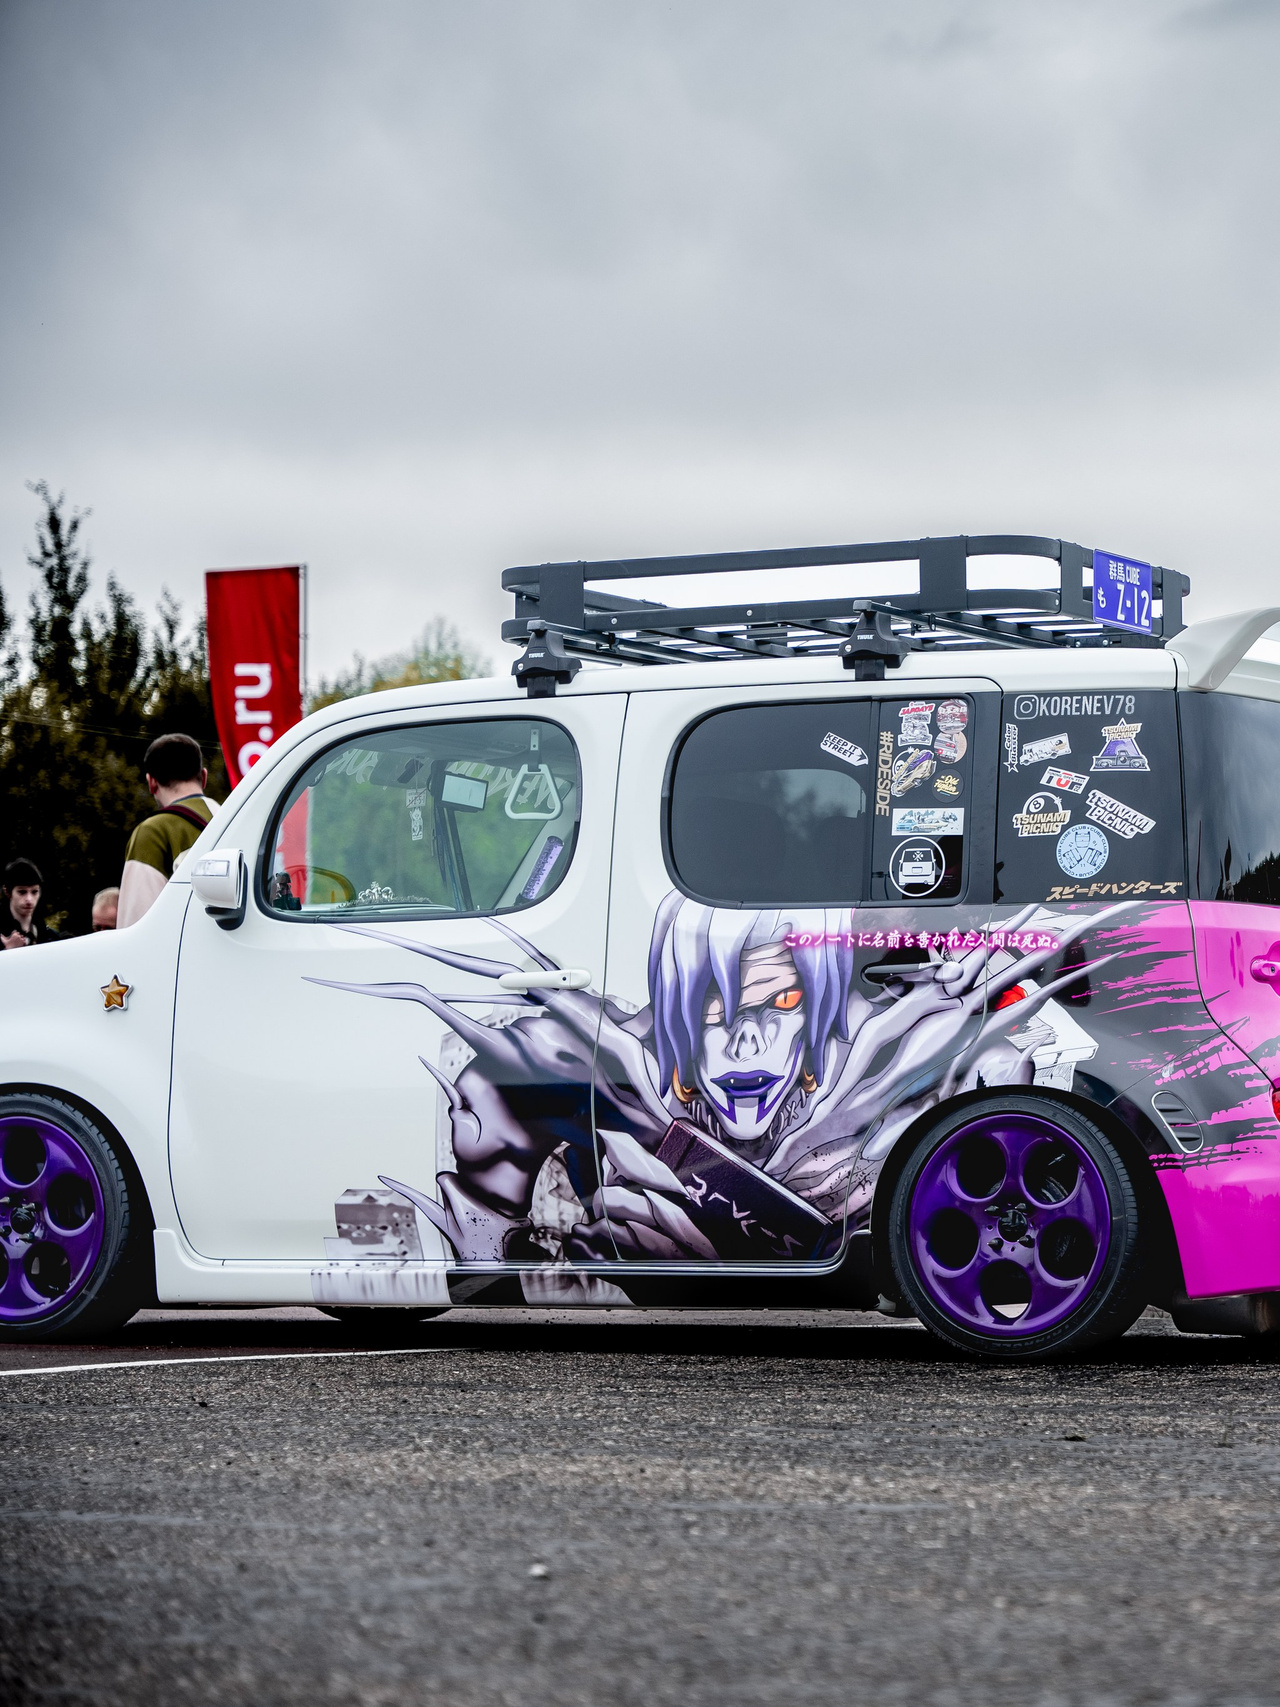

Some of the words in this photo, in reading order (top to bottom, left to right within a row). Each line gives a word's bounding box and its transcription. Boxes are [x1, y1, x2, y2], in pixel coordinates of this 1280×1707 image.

[1040, 694, 1135, 716] KORENEV78
[822, 740, 855, 758] STREET
[826, 733, 848, 747] KEEP
[849, 744, 859, 753] IT
[875, 731, 895, 817] #RIDESIDE
[1015, 811, 1069, 823] TSUNAMI
[1090, 791, 1153, 832] TSUNAMI
[1091, 806, 1138, 837] PICNIC
[1022, 822, 1062, 834] PICNIC
[1046, 880, 1182, 901] スピードハンターズ
